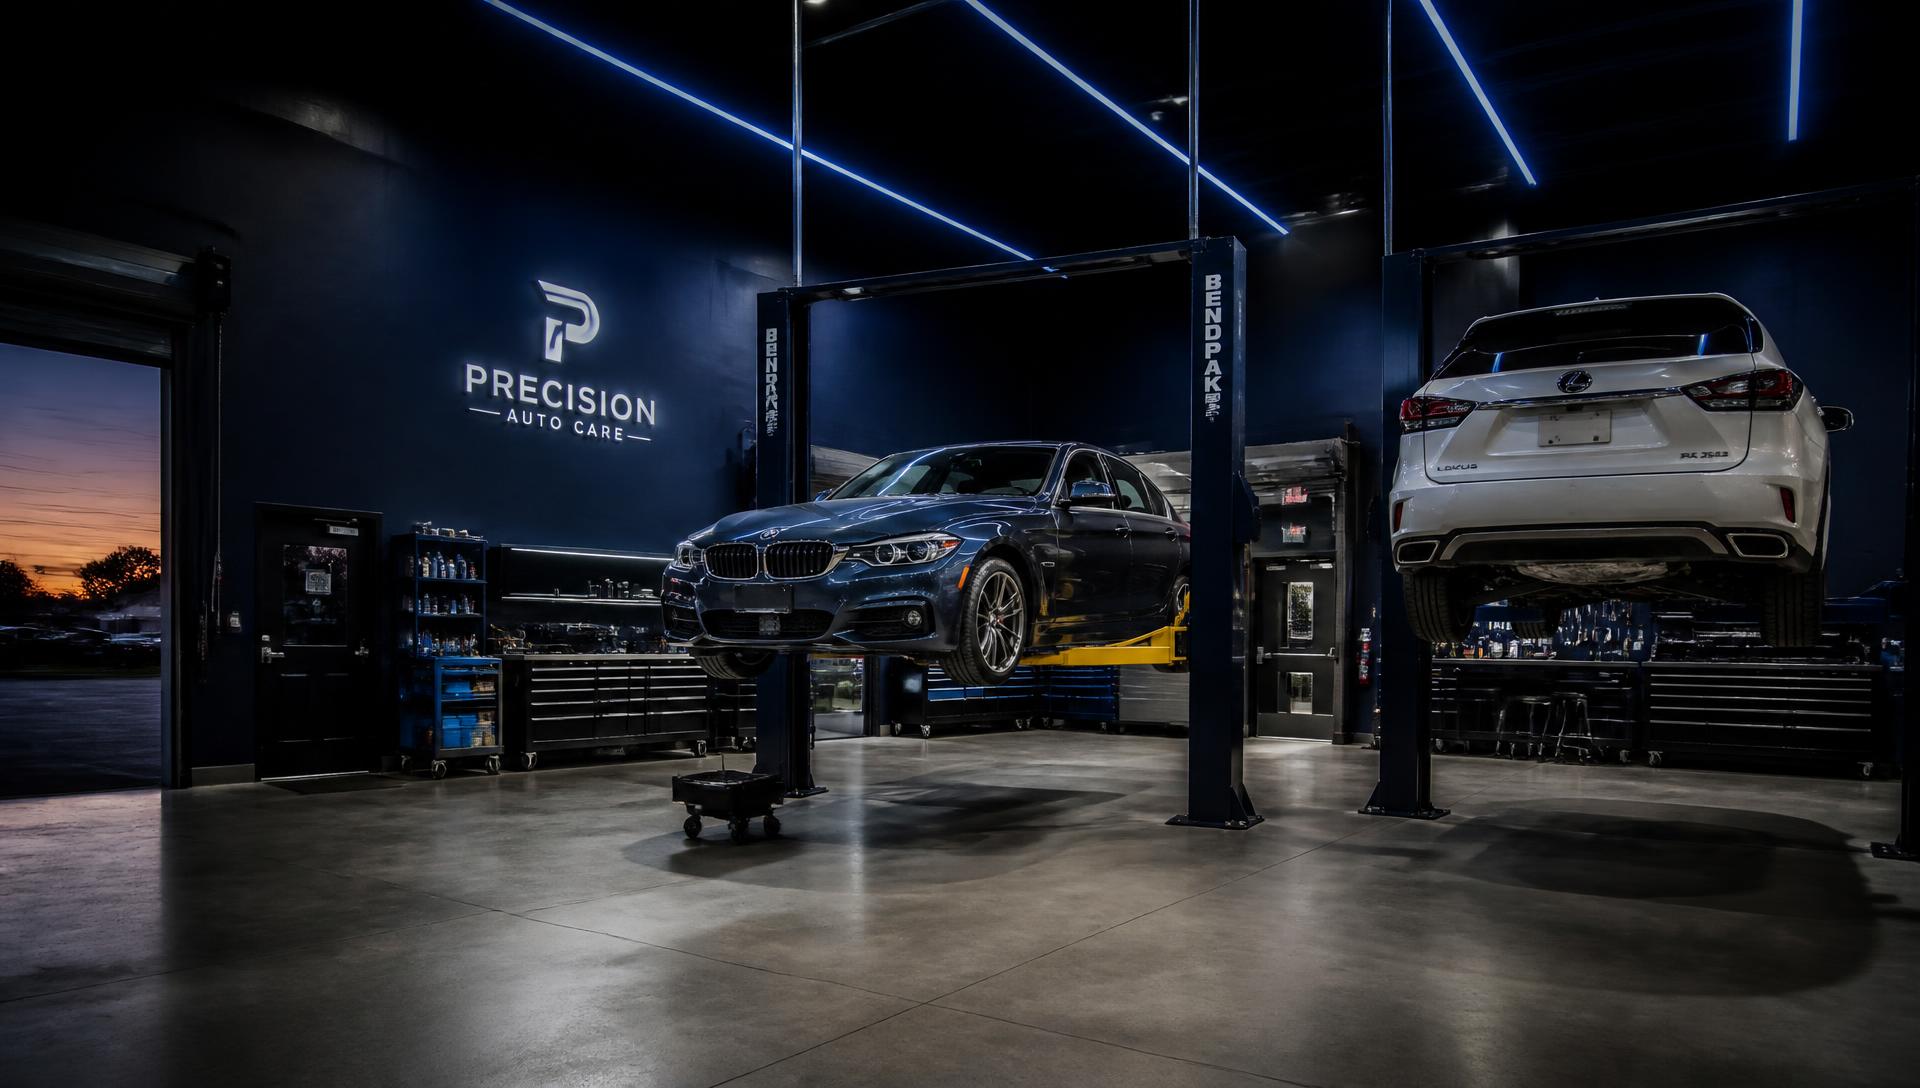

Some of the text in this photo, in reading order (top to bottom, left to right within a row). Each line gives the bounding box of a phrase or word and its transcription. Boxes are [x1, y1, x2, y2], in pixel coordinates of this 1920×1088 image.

[1204, 274, 1222, 393] BENDPAK
[465, 363, 656, 425] PRECISION
[507, 408, 624, 441] AUTO CARE
